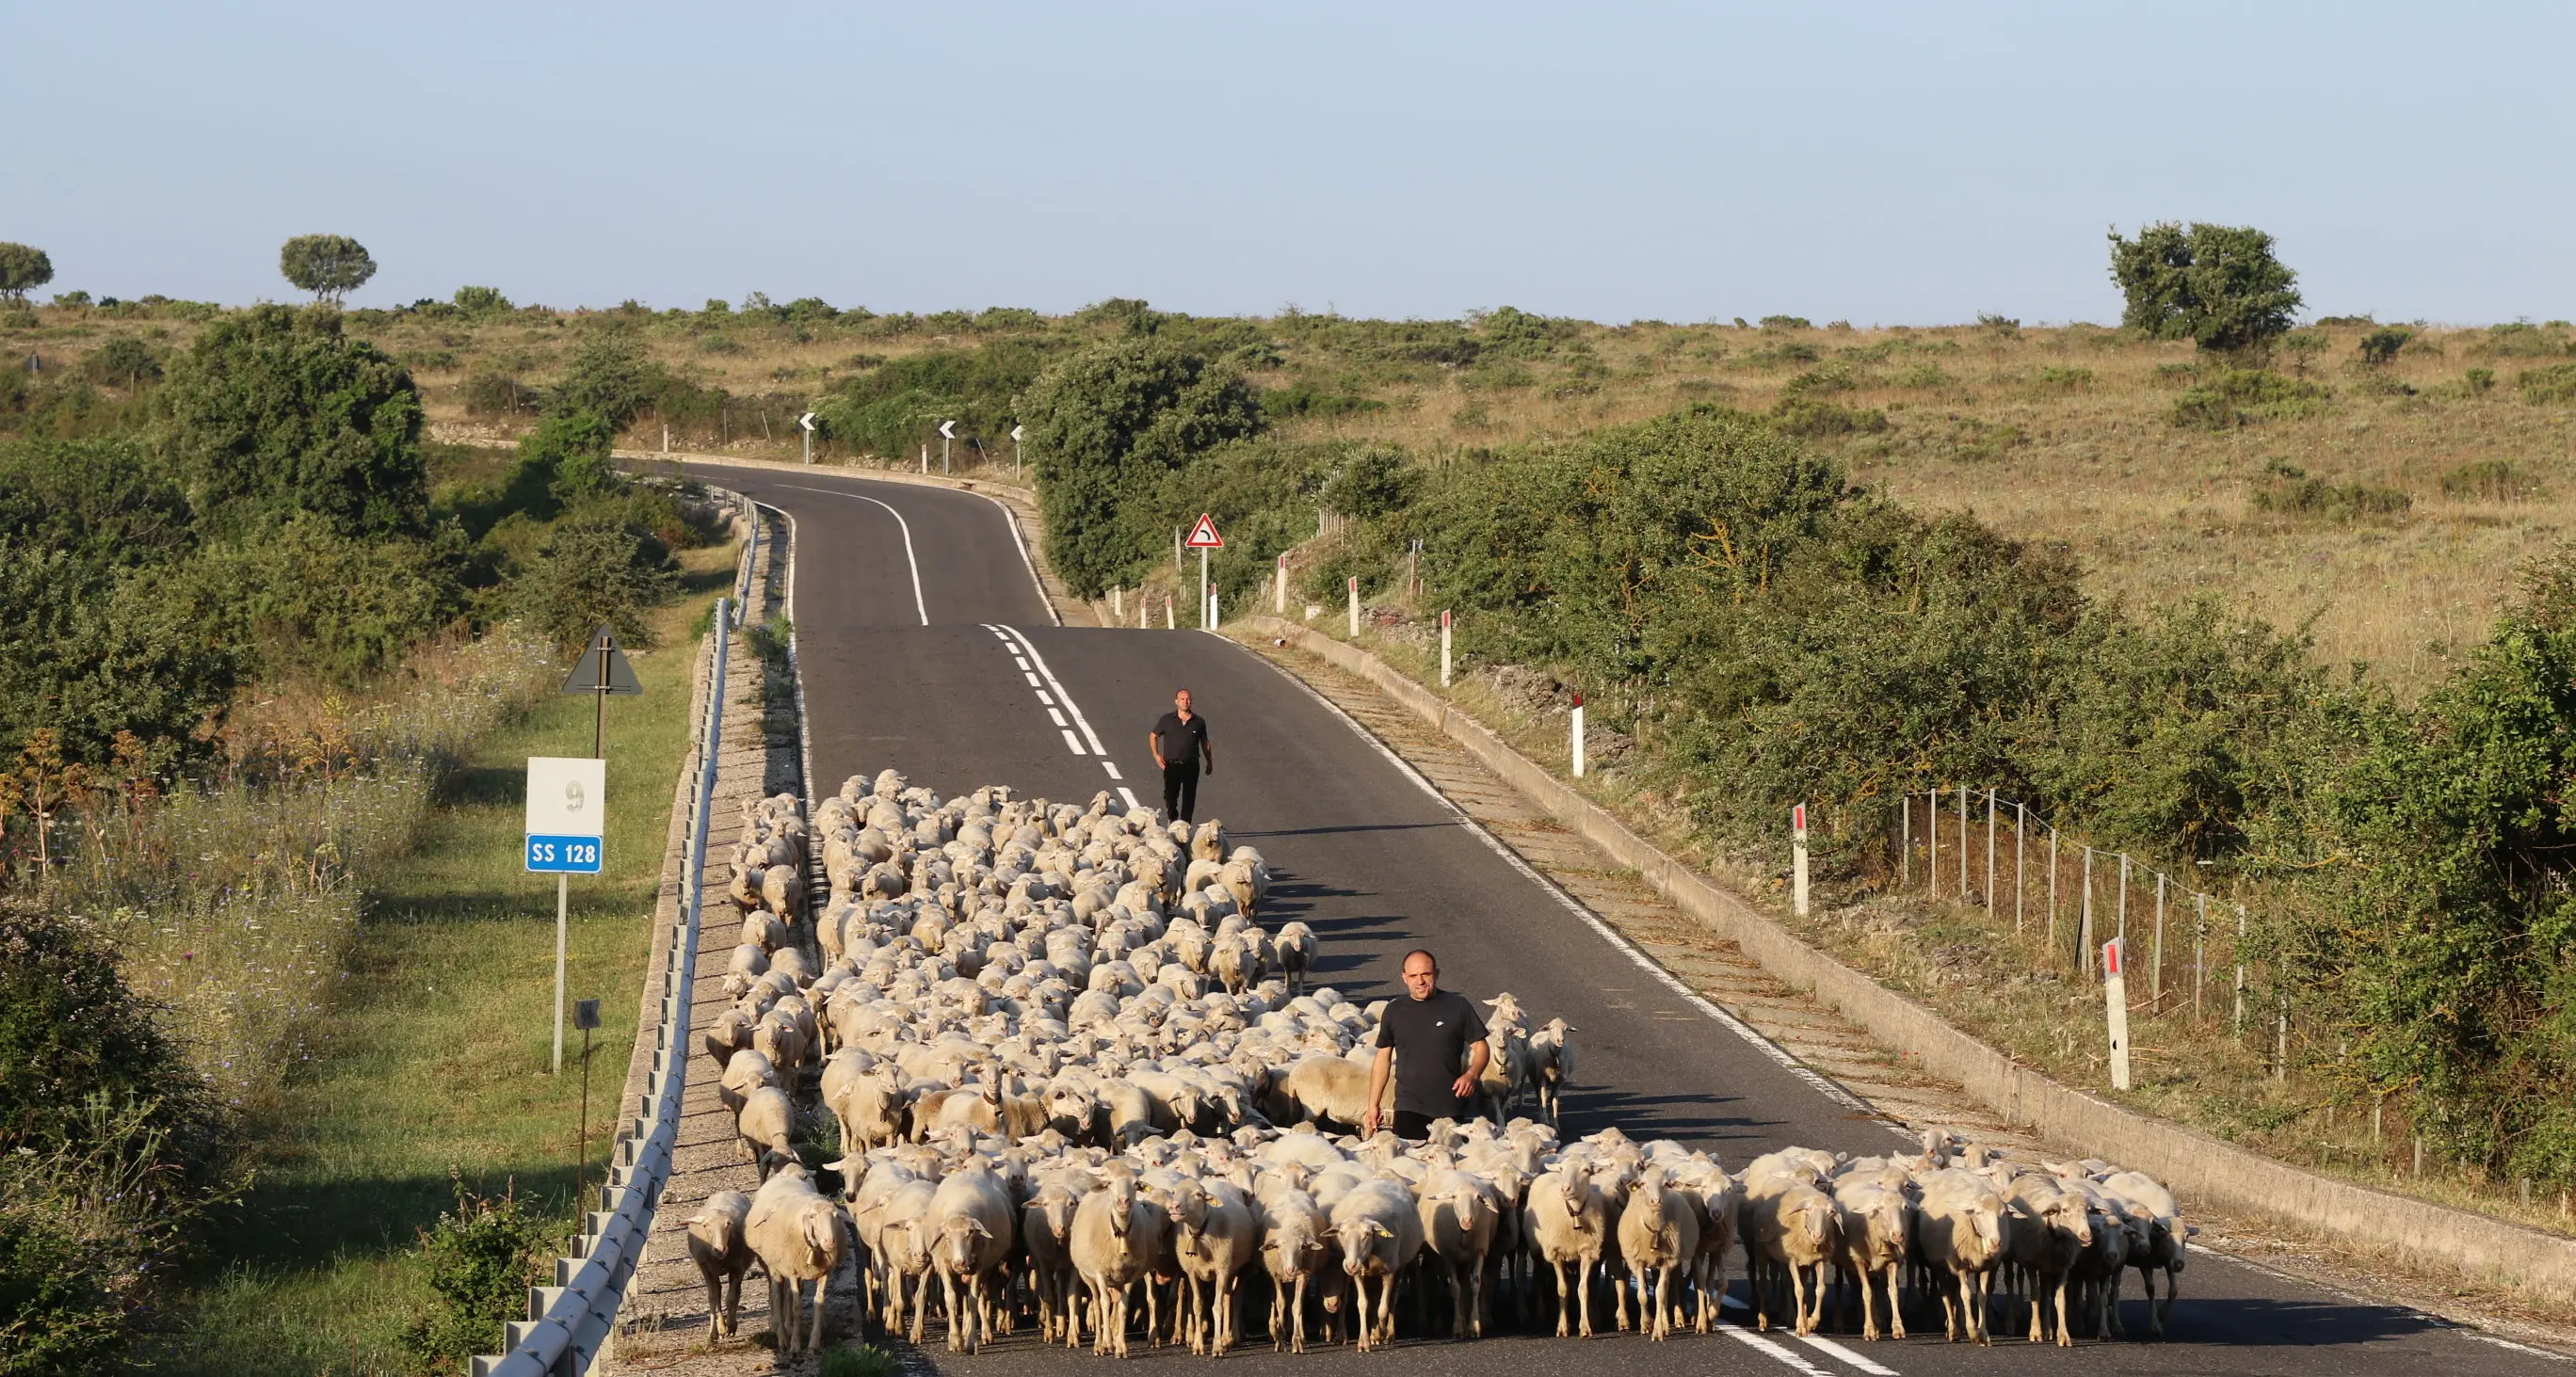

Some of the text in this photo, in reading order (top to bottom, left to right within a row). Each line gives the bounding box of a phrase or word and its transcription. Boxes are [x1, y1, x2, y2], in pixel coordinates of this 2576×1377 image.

[566, 780, 585, 813] 9
[532, 843, 595, 863] SS 128
